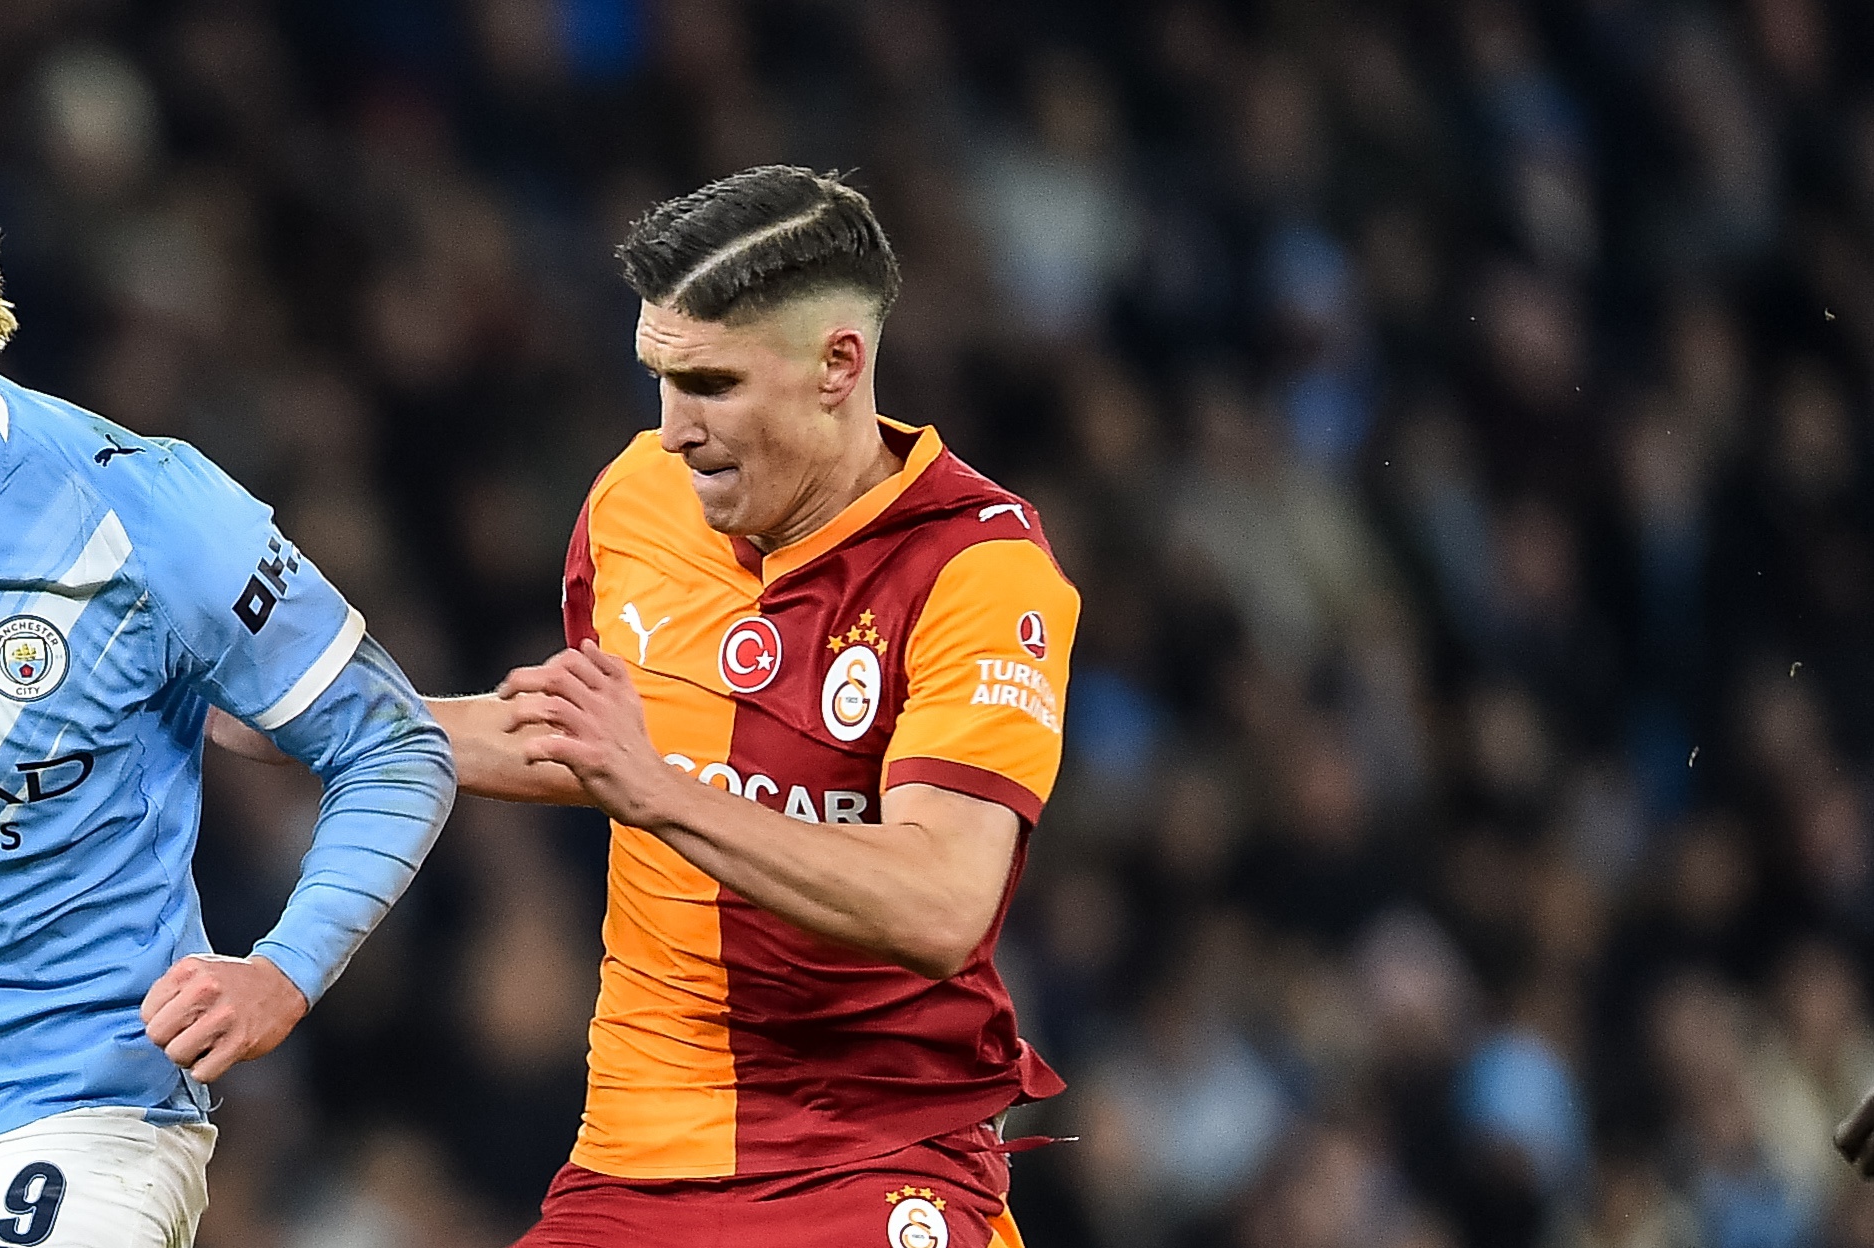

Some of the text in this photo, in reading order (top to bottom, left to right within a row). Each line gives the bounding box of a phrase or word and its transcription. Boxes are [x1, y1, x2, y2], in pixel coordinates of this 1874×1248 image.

[231, 534, 301, 635] OK
[15, 686, 41, 696] CITY
[969, 683, 1062, 734] AIRLE
[975, 658, 1057, 712] TURK
